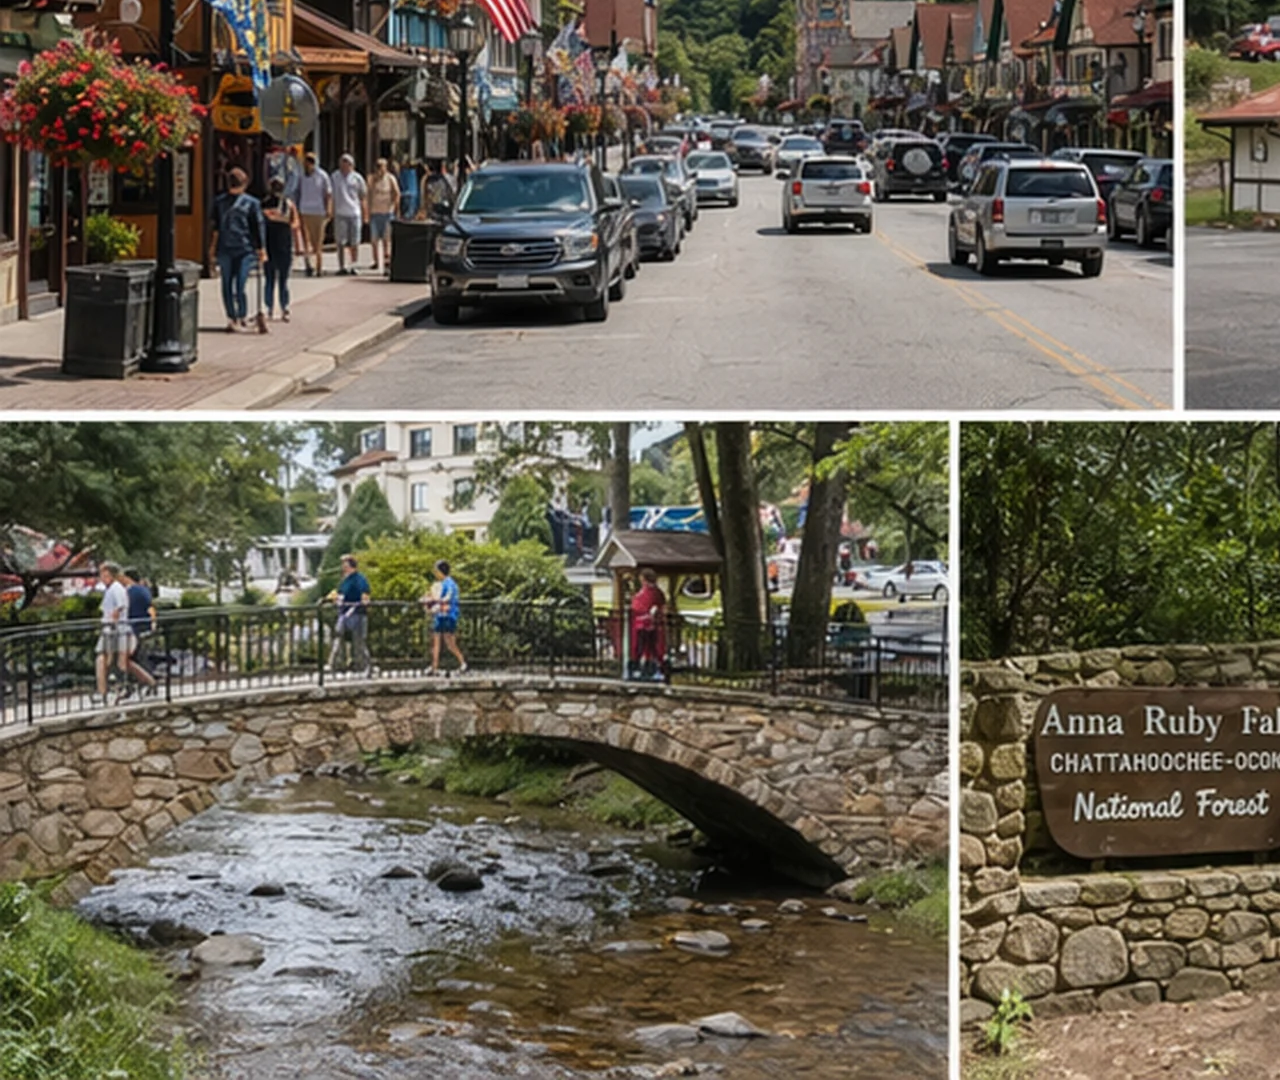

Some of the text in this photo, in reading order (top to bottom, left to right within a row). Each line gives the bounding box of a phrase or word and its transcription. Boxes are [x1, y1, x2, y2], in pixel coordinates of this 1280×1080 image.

[1041, 703, 1124, 735] Anna
[1143, 704, 1222, 742] Ruby
[1073, 788, 1270, 822] National Forest
